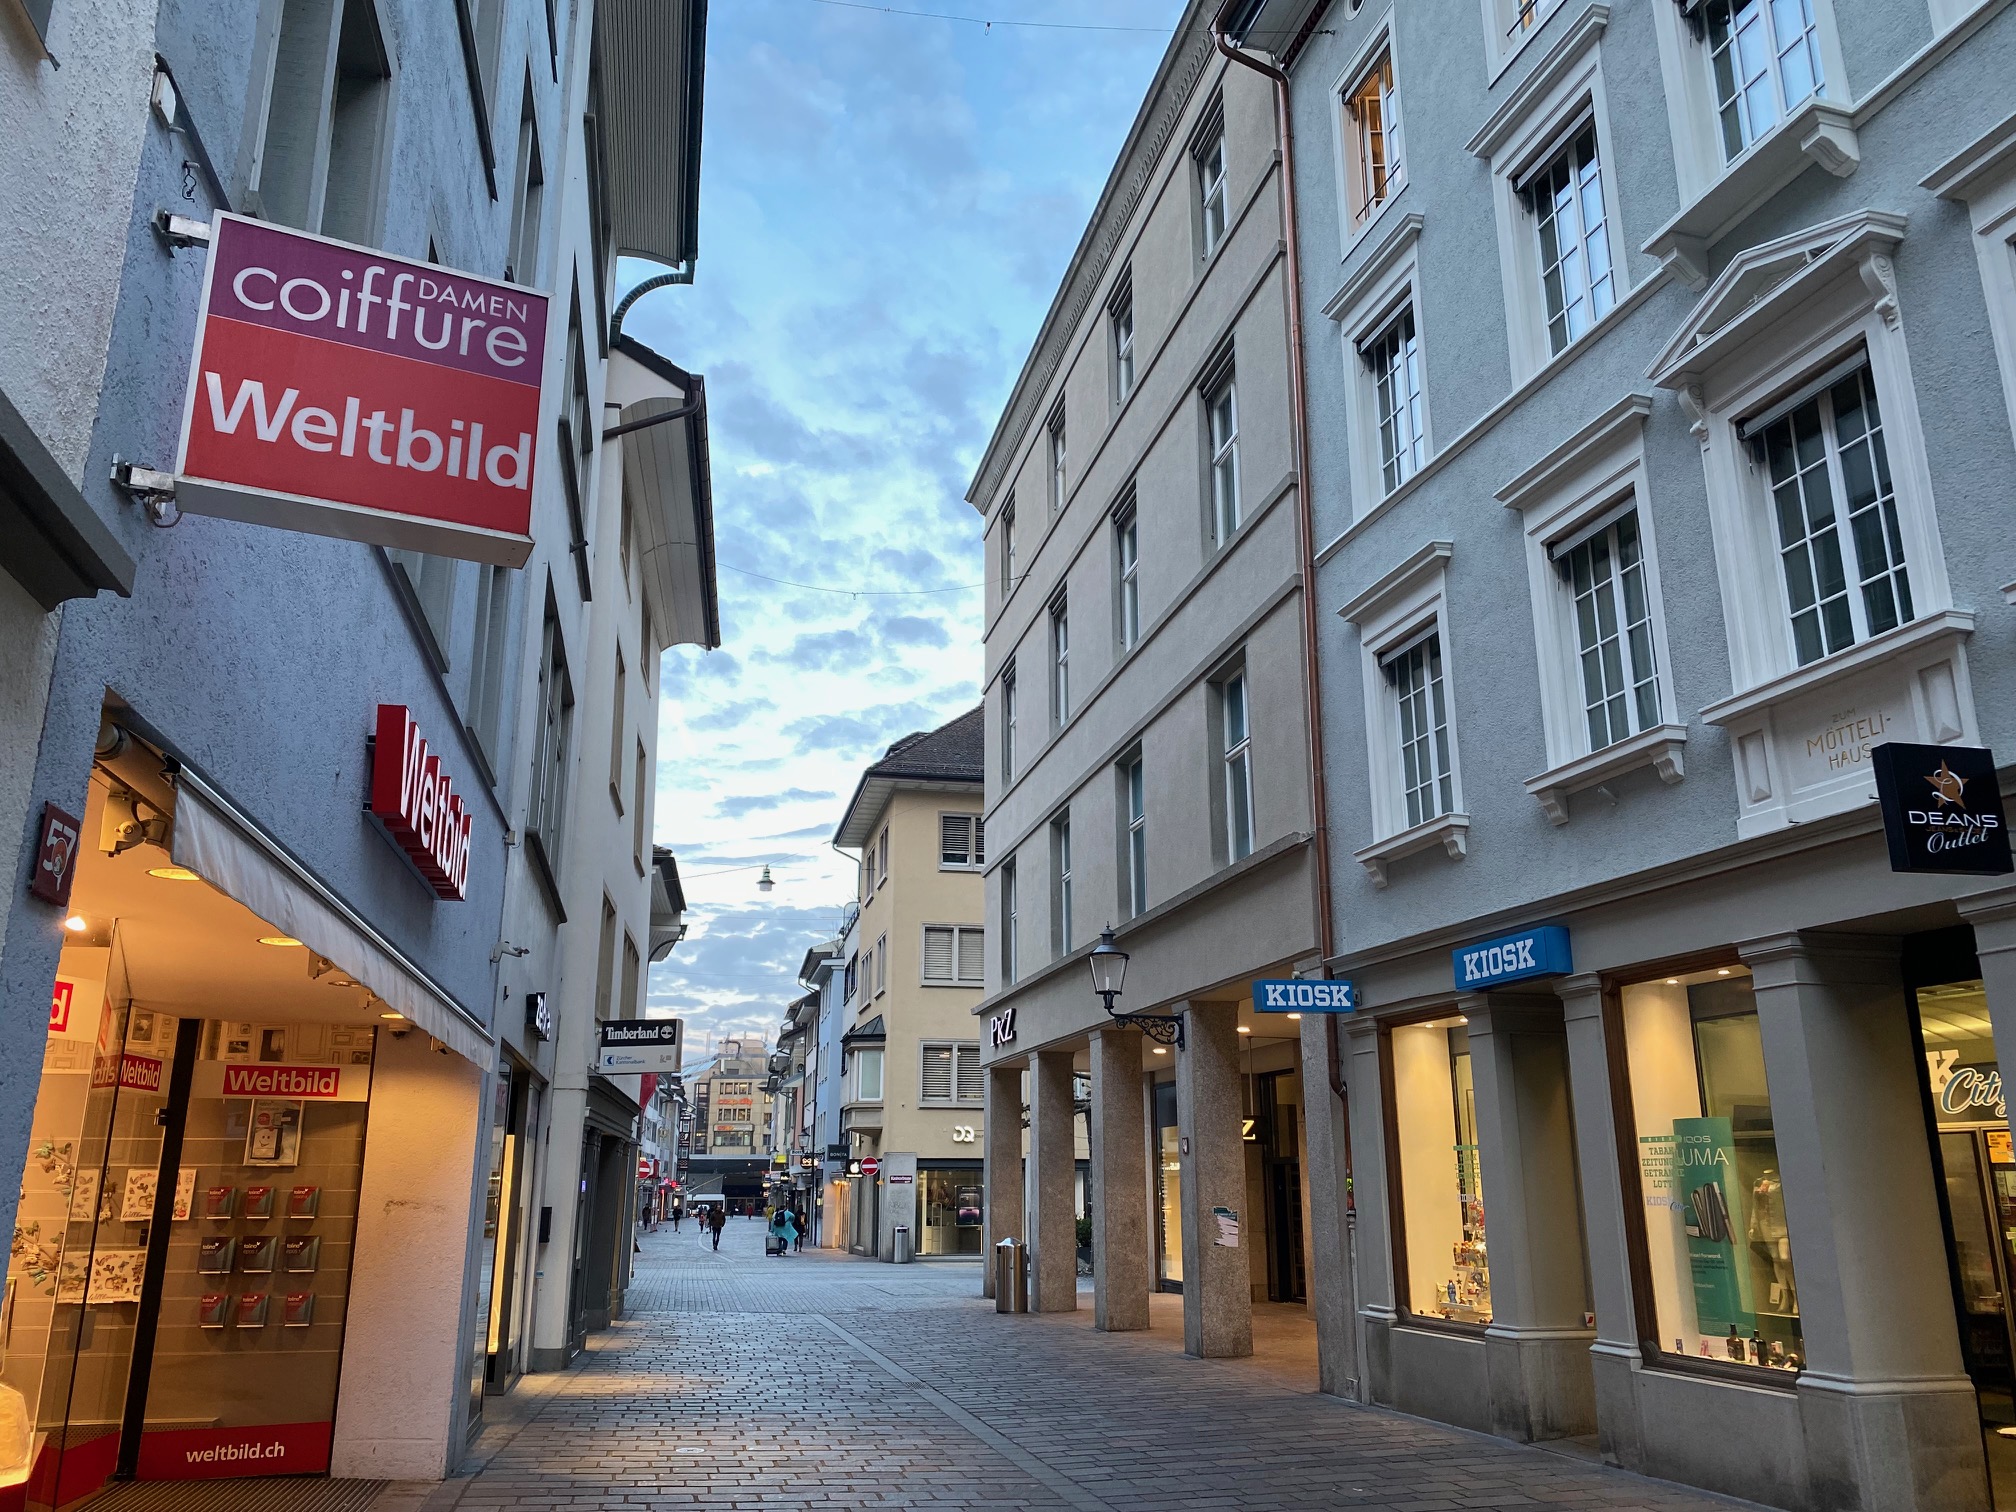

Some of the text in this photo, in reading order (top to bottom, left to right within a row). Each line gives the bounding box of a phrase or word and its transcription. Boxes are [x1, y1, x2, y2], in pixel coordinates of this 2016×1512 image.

[418, 277, 528, 324] DAMEN
[232, 265, 528, 367] coiffure
[204, 370, 533, 491] Weltbild
[1831, 707, 1857, 723] ZUM
[1828, 742, 1873, 771] HAUS
[400, 706, 474, 901] Weltbild
[1908, 811, 1999, 828] DEANS
[1926, 824, 1989, 853] Outlet
[1462, 938, 1536, 982] KIOSK
[1265, 984, 1351, 1007] KIOSK
[605, 1025, 659, 1040] Timberland
[989, 1008, 1013, 1047] PKZ
[121, 1060, 161, 1088] Weltbild
[228, 1069, 336, 1094] Weltbild
[1683, 1135, 1712, 1144] IQOS
[186, 1441, 285, 1463] weltbild.ch
